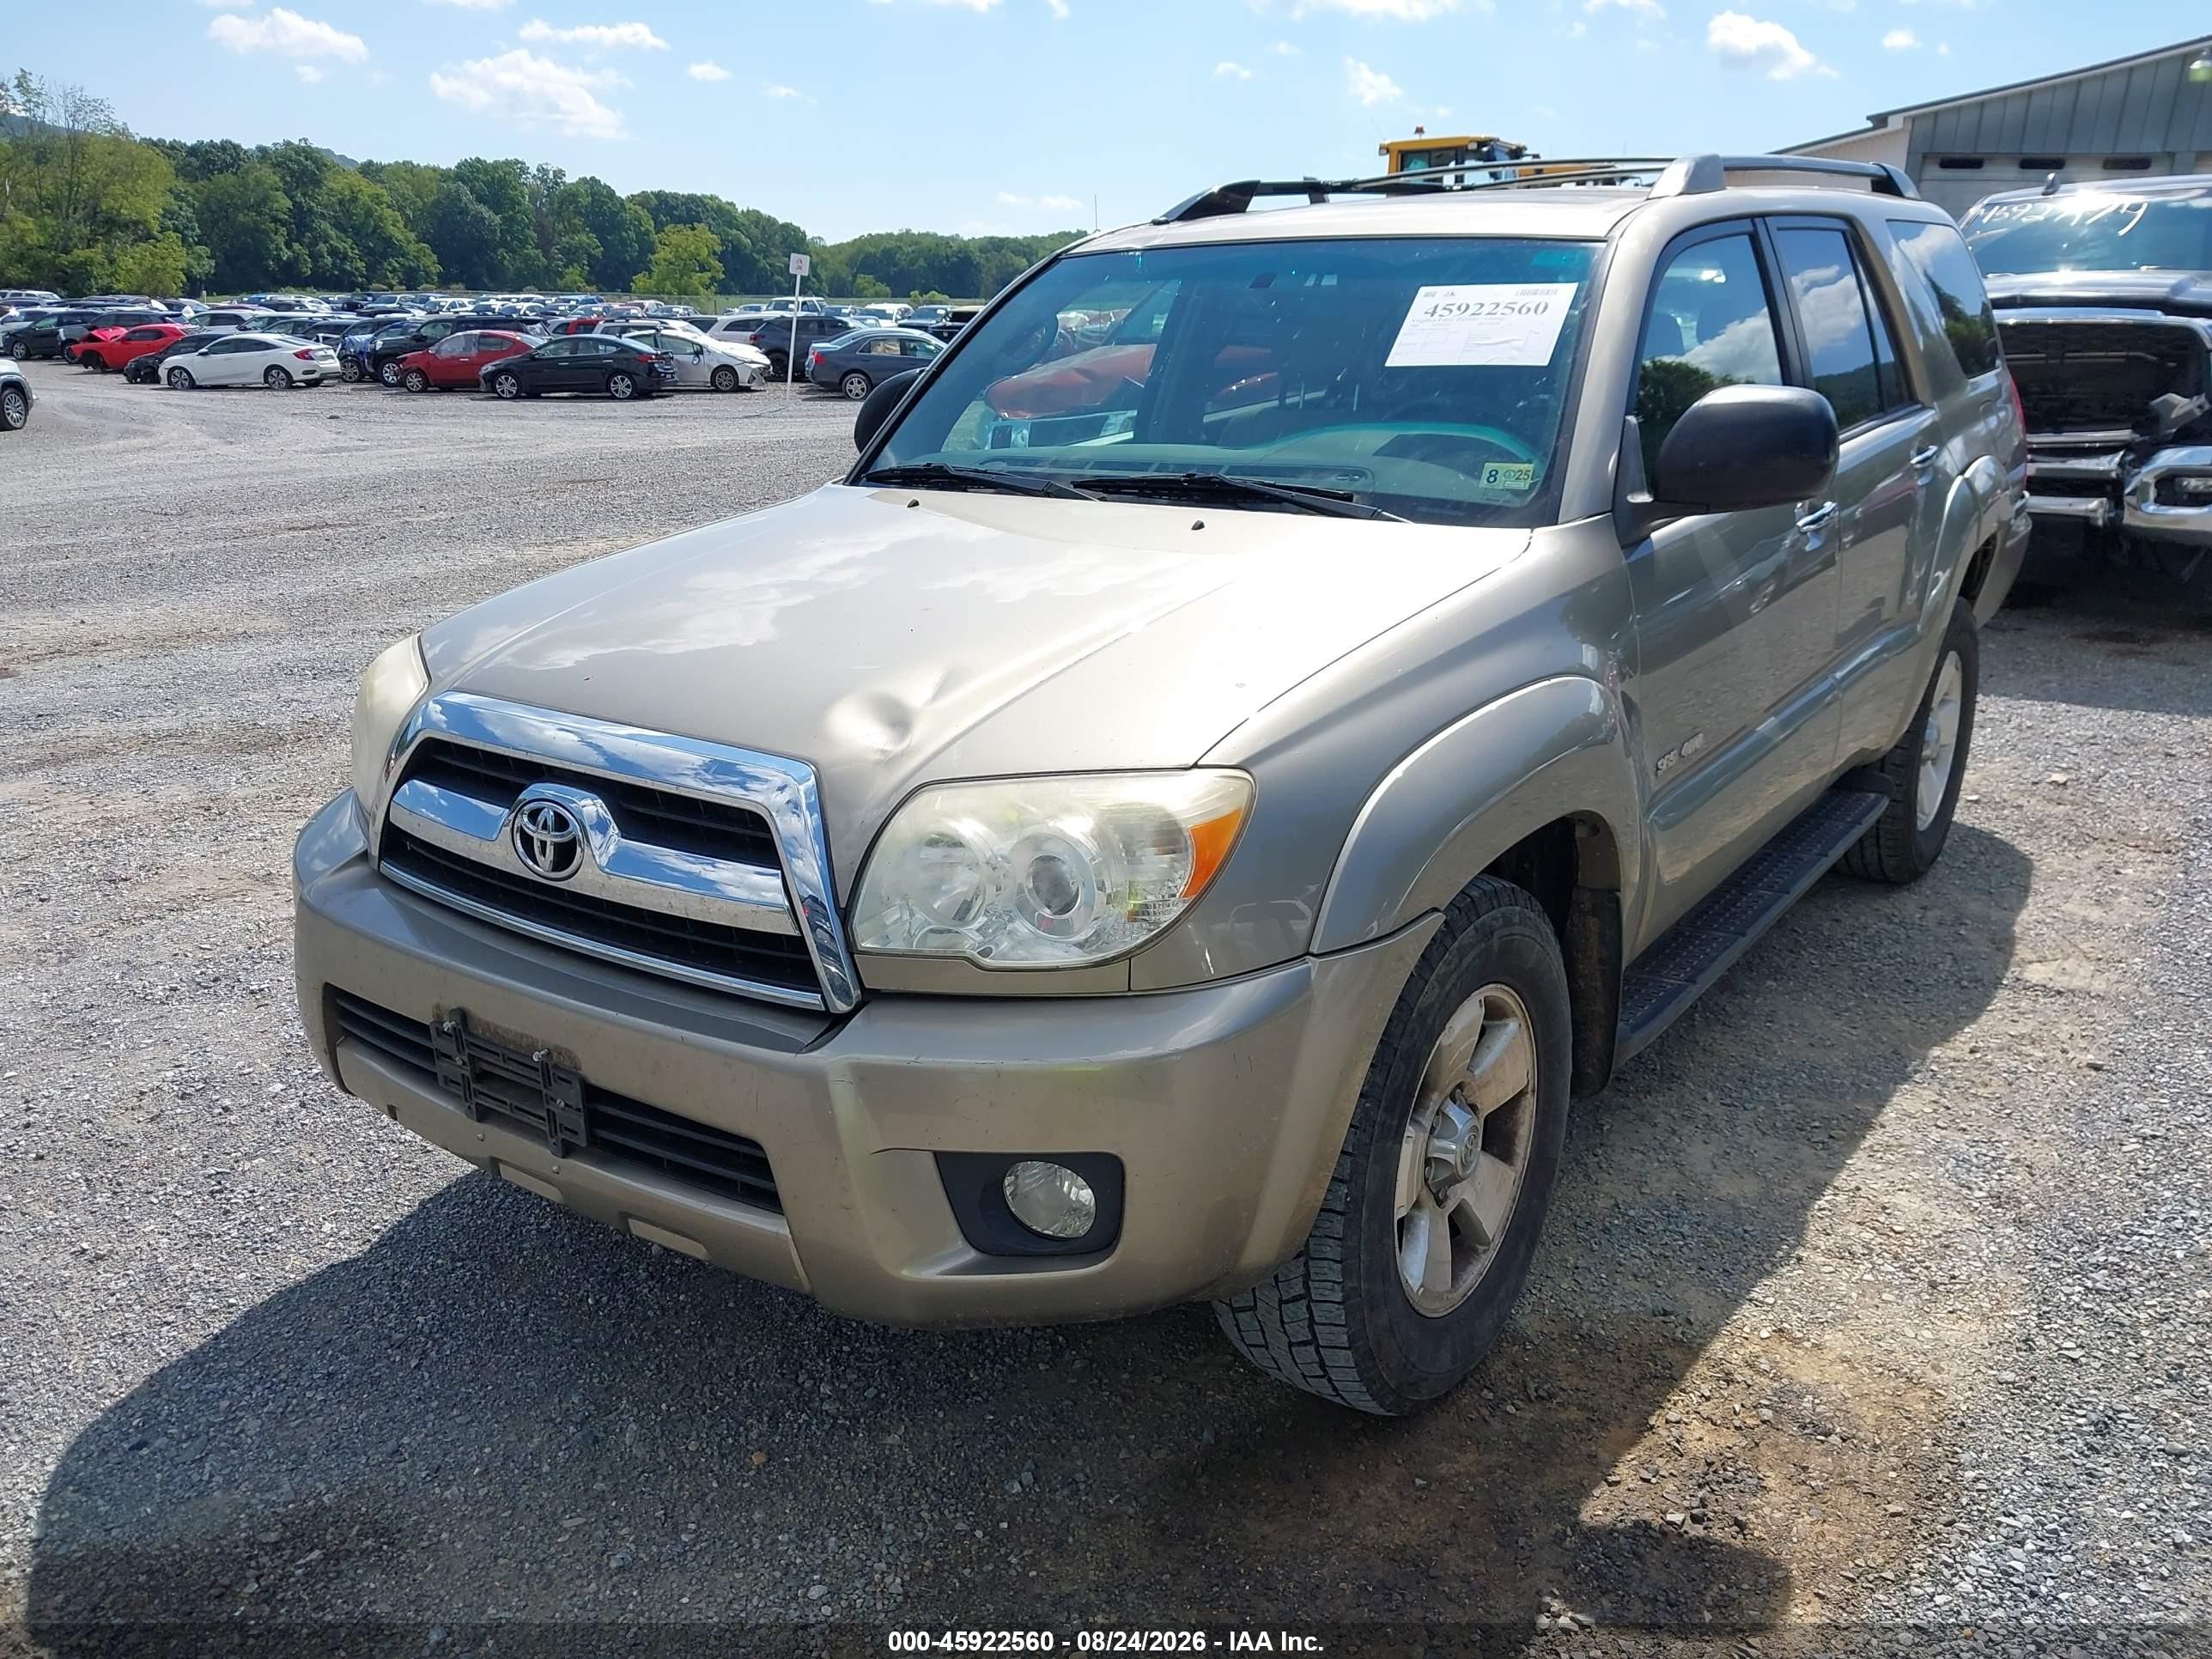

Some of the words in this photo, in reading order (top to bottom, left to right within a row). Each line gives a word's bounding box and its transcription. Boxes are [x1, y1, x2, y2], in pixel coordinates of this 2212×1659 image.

[1424, 301, 1549, 318] 45922560
[1486, 469, 1499, 483] 8
[1515, 469, 1531, 481] 25
